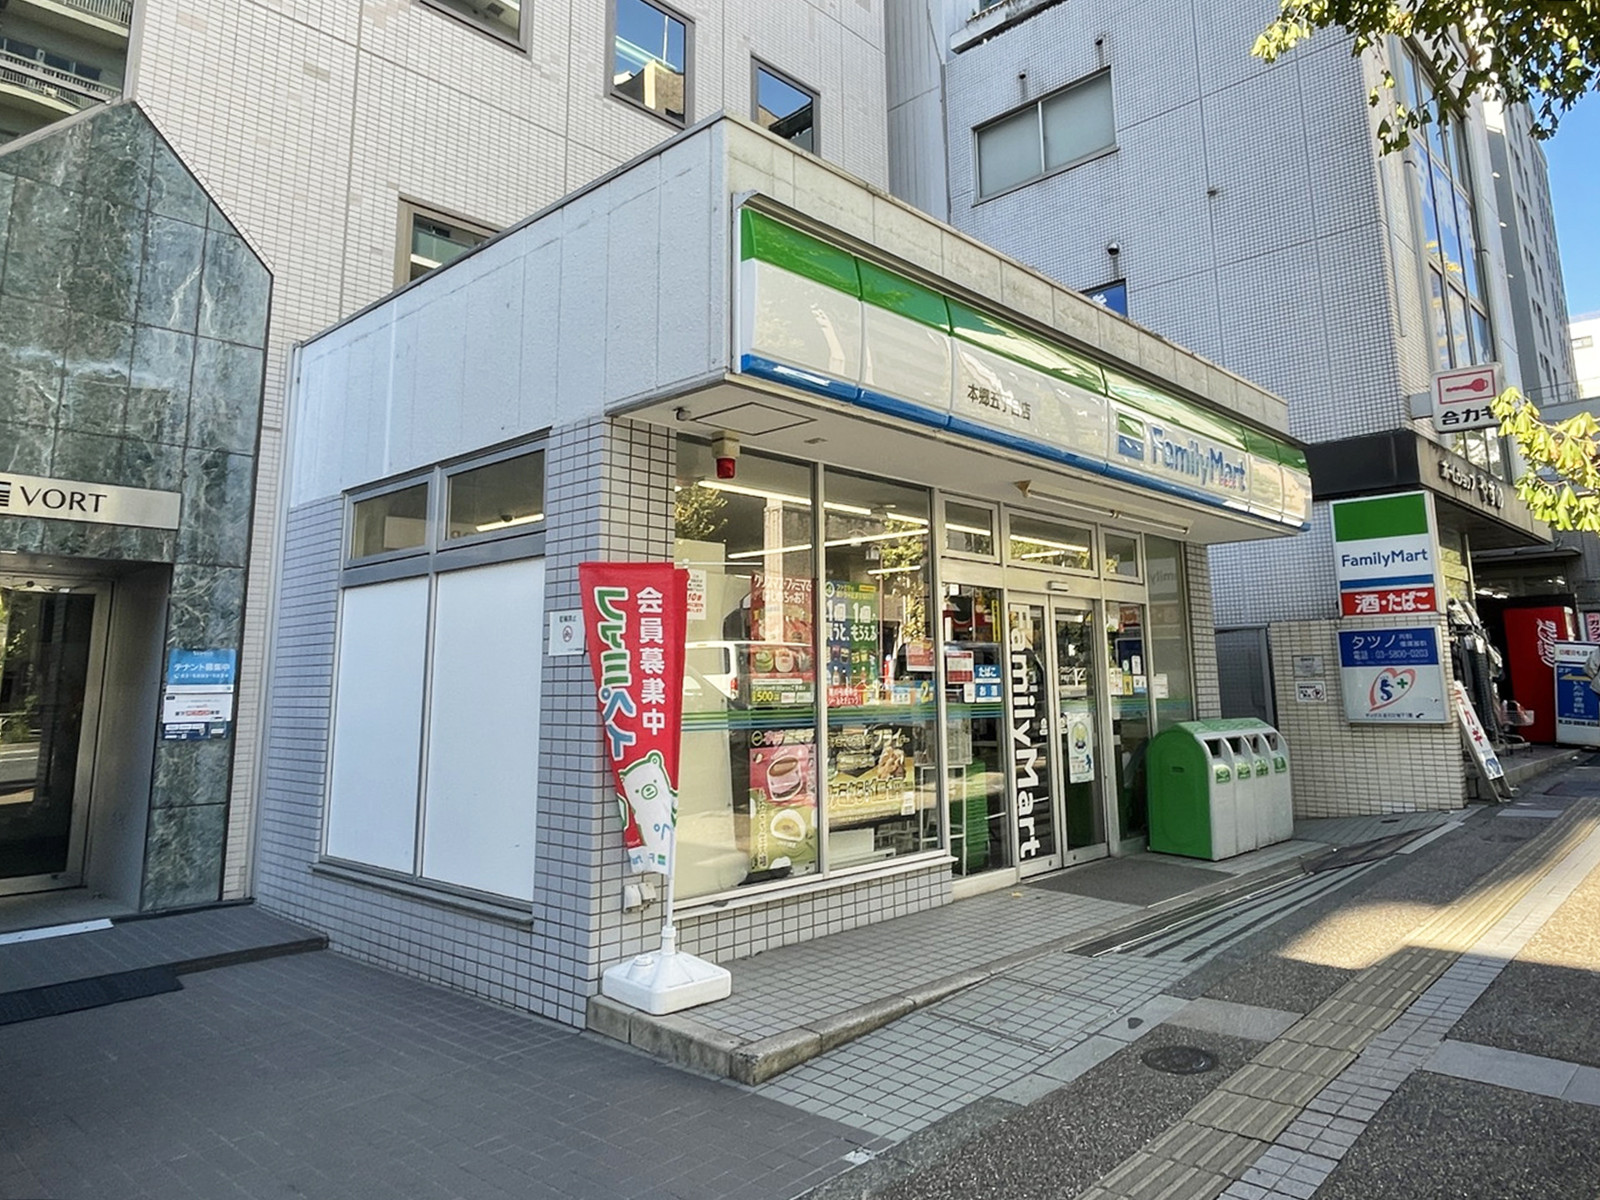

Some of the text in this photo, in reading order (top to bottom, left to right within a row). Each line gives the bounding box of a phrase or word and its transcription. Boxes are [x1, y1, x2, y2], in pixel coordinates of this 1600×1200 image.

[1152, 427, 1246, 491] FamilyMart
[20, 486, 107, 513] VORT
[1341, 548, 1428, 567] FamilyMart
[1355, 591, 1430, 613] 酒・たばこ
[1352, 634, 1396, 650] タツノ
[1009, 603, 1041, 860] FamilyMart
